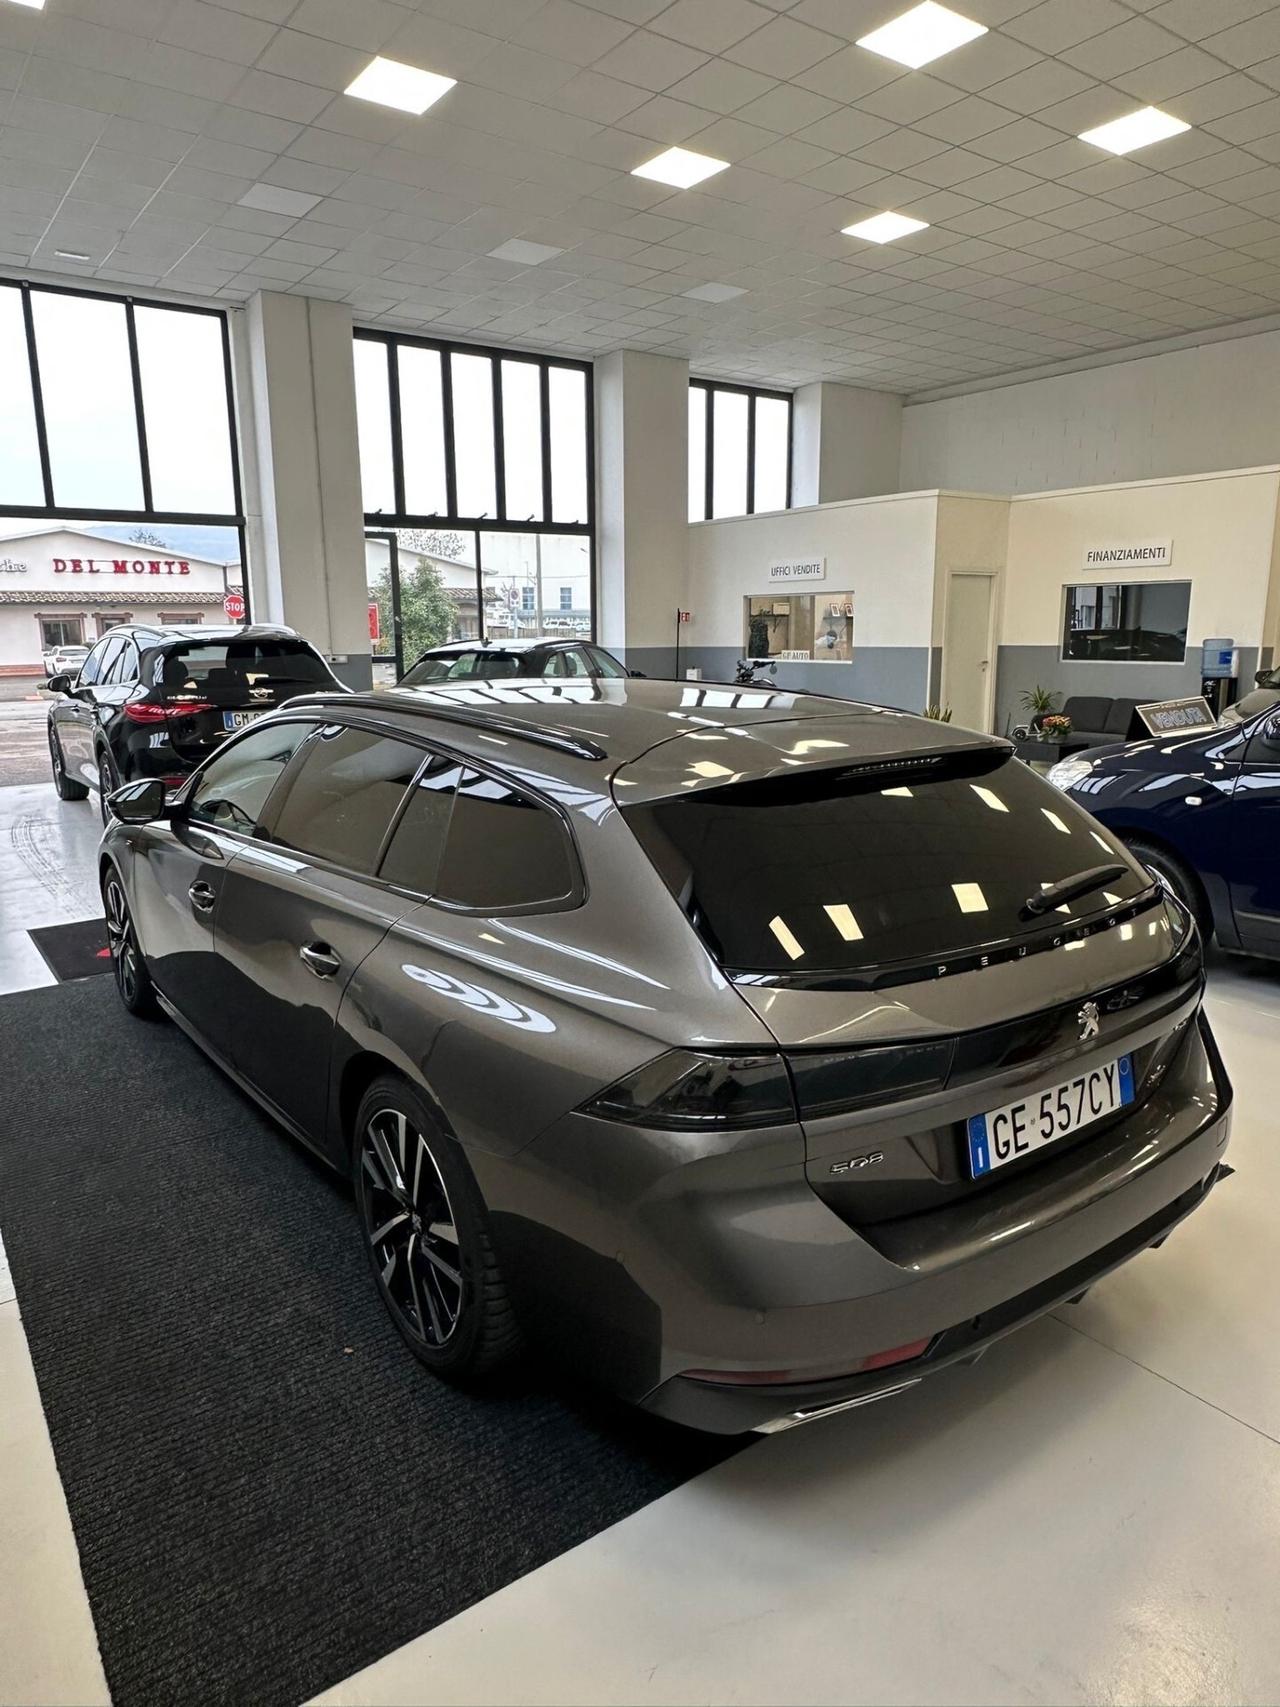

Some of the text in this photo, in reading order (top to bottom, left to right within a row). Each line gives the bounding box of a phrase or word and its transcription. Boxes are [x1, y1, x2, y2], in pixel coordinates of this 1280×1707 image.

[1087, 547, 1166, 562] FINANZIAMENTI
[53, 558, 100, 573] DEL
[112, 560, 191, 575] MONTE
[771, 564, 820, 576] UFFICI VENDITE
[225, 602, 245, 611] STOP
[830, 1151, 884, 1175] 508
